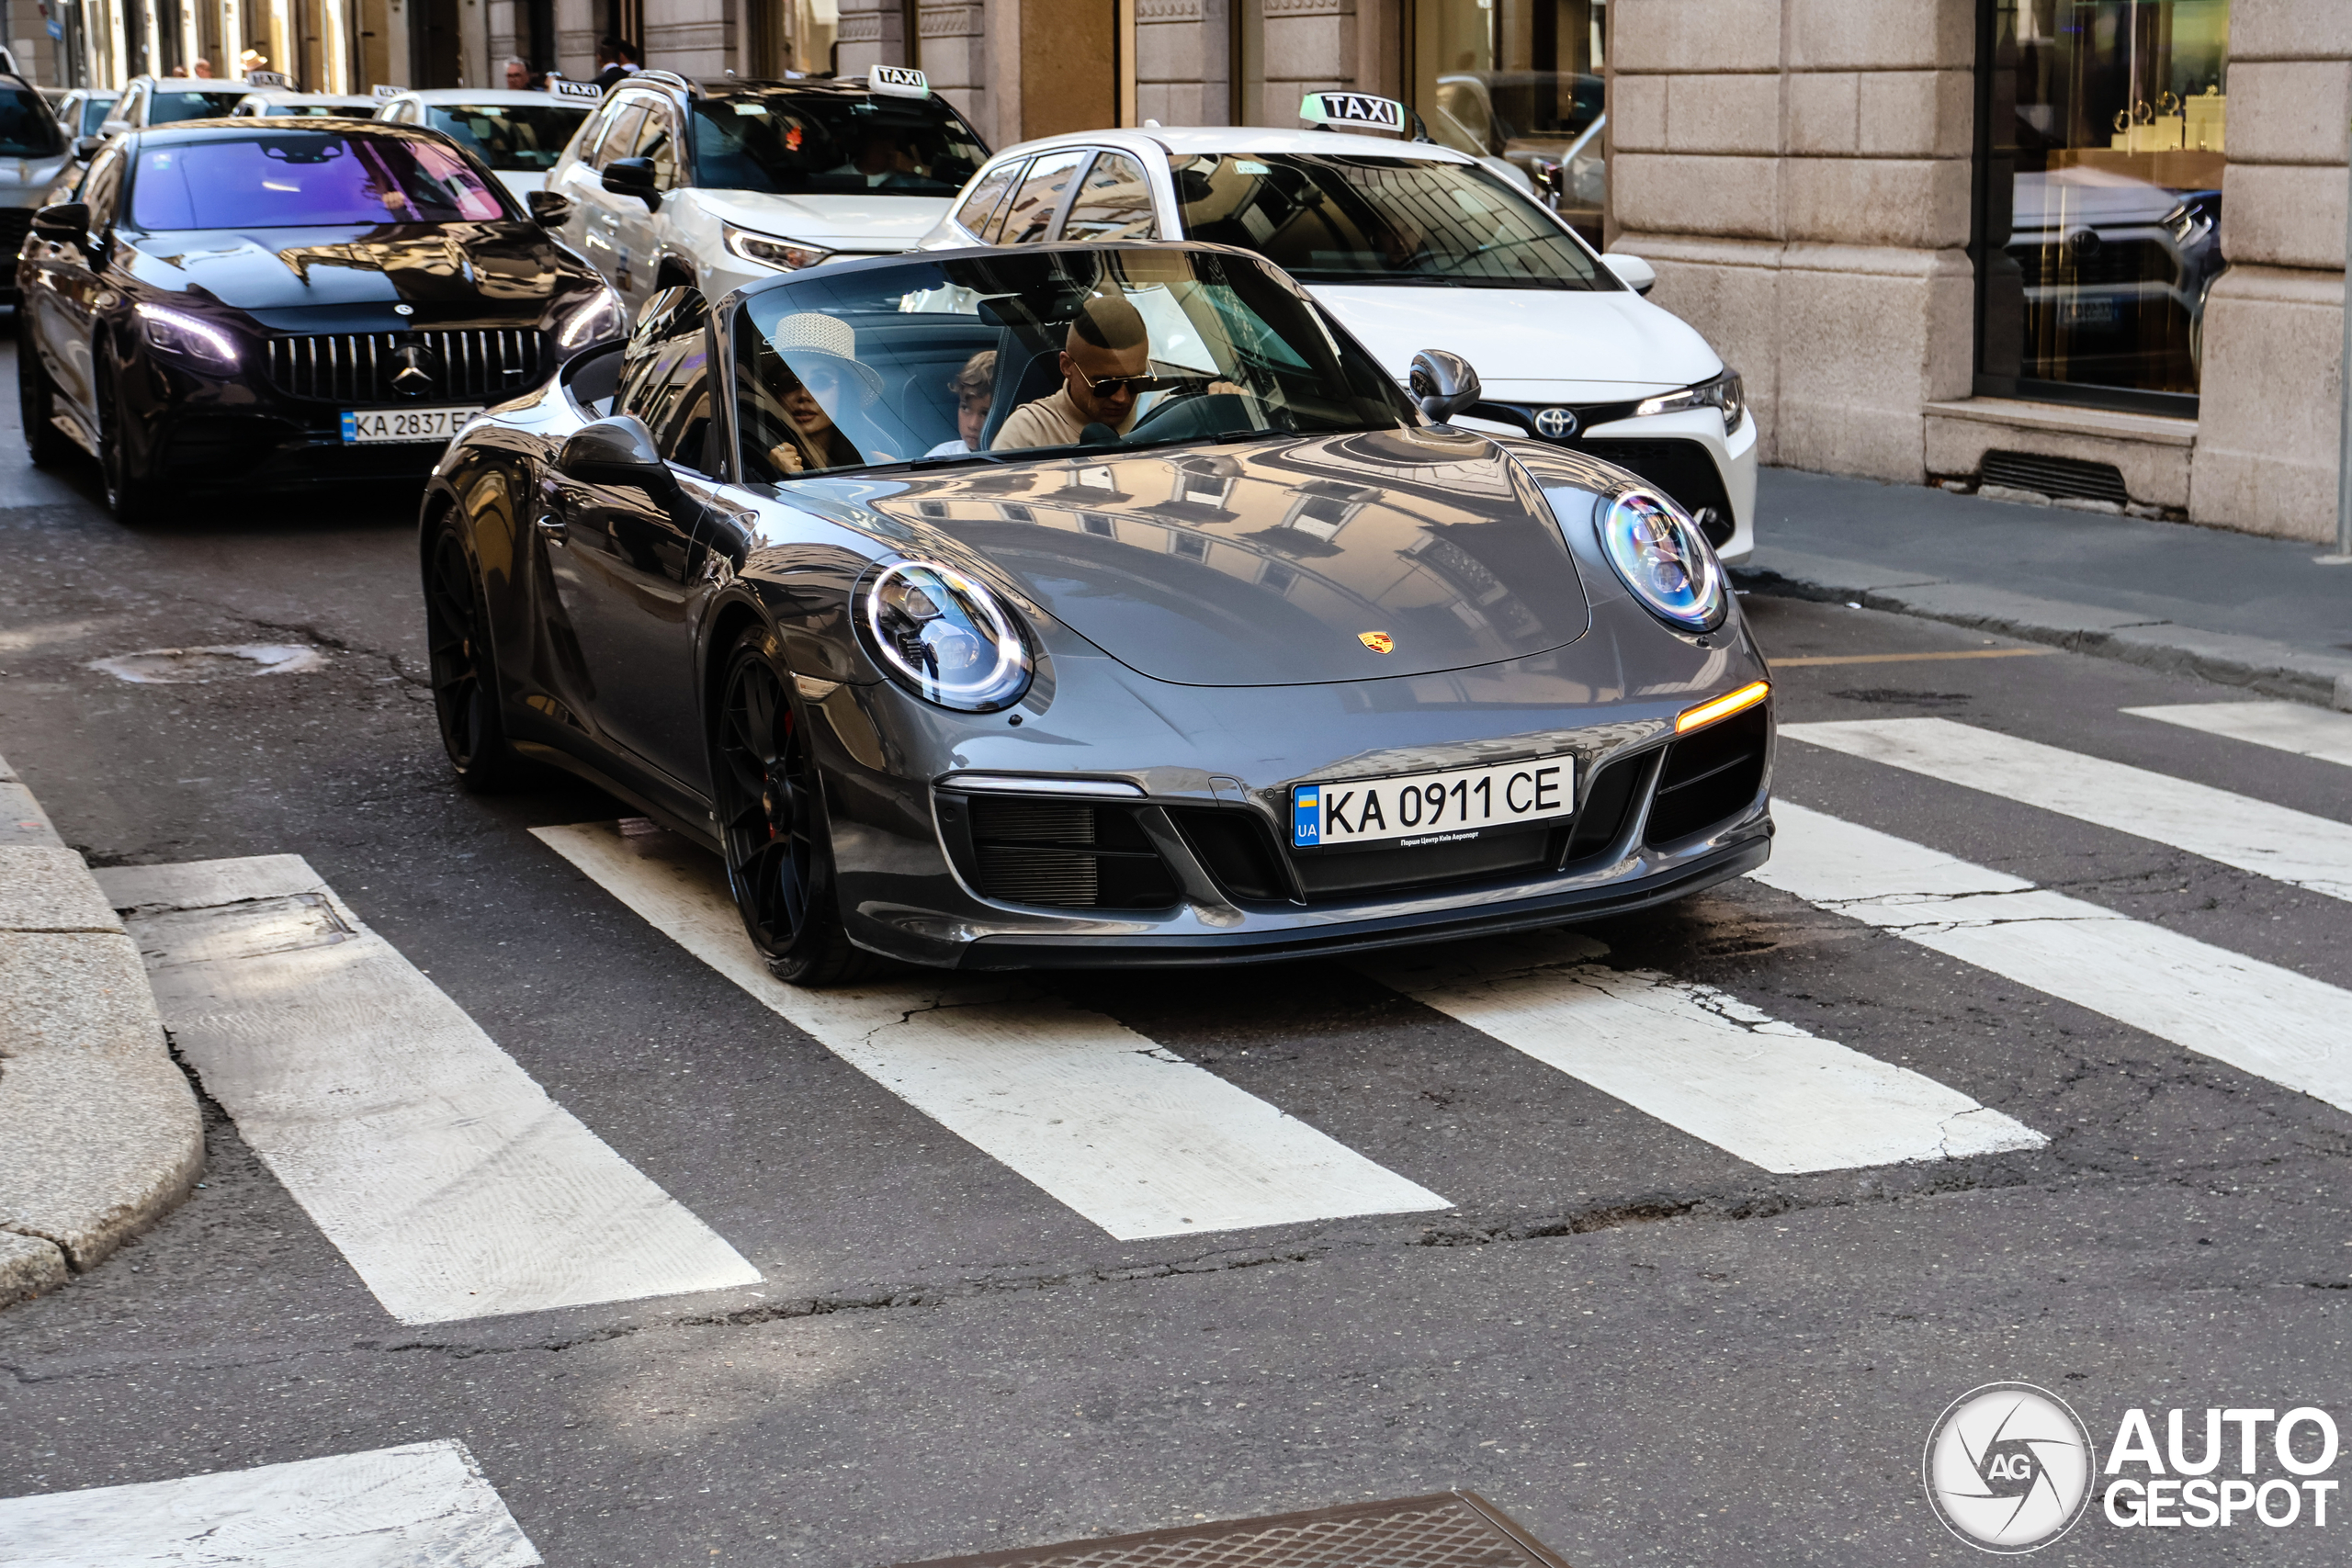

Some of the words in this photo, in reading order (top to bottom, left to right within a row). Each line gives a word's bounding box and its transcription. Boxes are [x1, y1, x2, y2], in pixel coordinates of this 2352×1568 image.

[879, 68, 922, 86] TAXI
[560, 83, 597, 97] TAXI
[1325, 96, 1396, 124] TAXI
[356, 415, 388, 437] KA
[394, 413, 447, 435] 2837
[452, 412, 479, 434] E
[1326, 789, 1386, 835] KA
[1399, 776, 1491, 828] 0911
[1506, 766, 1561, 814] CE
[1297, 824, 1317, 838] UA
[1400, 839, 1420, 847] Порше
[1420, 836, 1439, 845] Центр
[1452, 831, 1479, 841] Аеропорт
